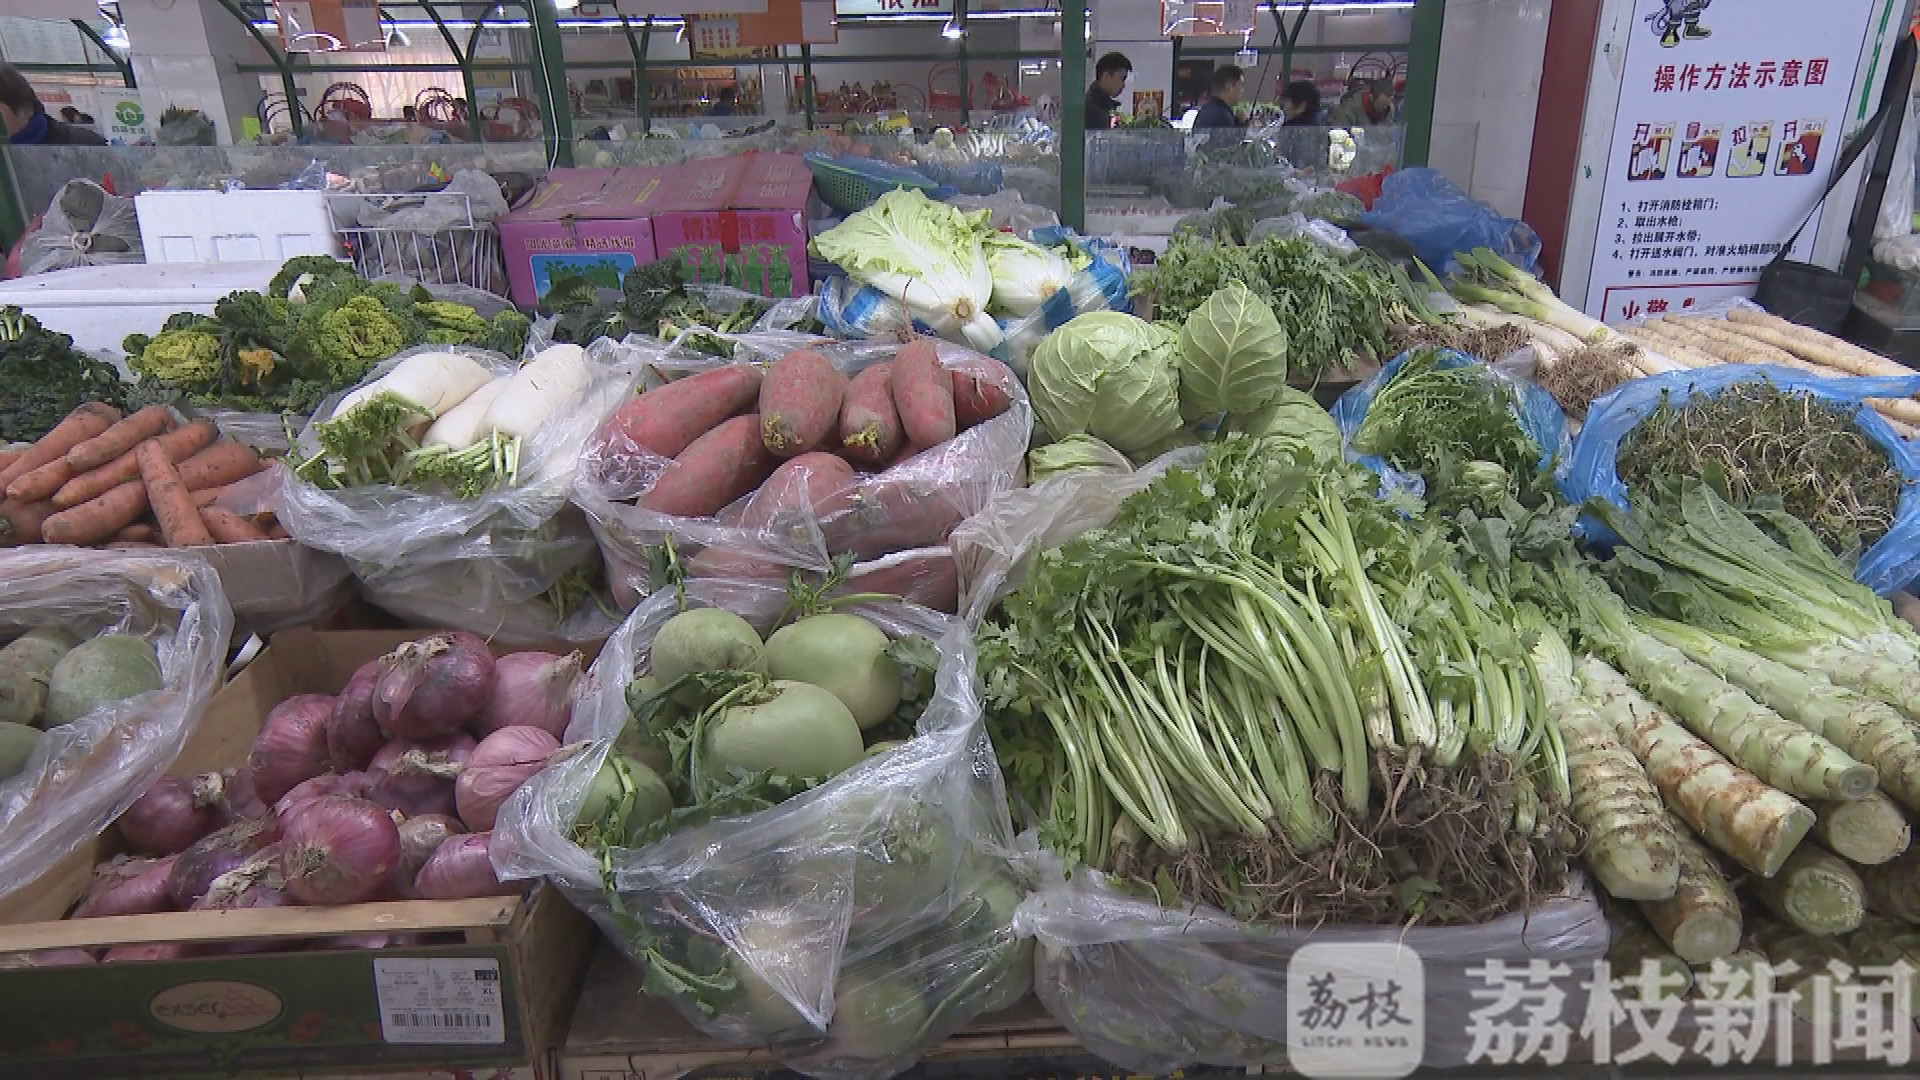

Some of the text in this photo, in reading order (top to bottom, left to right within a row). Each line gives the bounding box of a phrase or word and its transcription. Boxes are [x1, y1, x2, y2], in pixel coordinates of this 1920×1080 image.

[1653, 57, 1829, 93] 操作方法示意图
[1612, 243, 1798, 260] 4、打开送水阀门，对准火焰根部喷；
